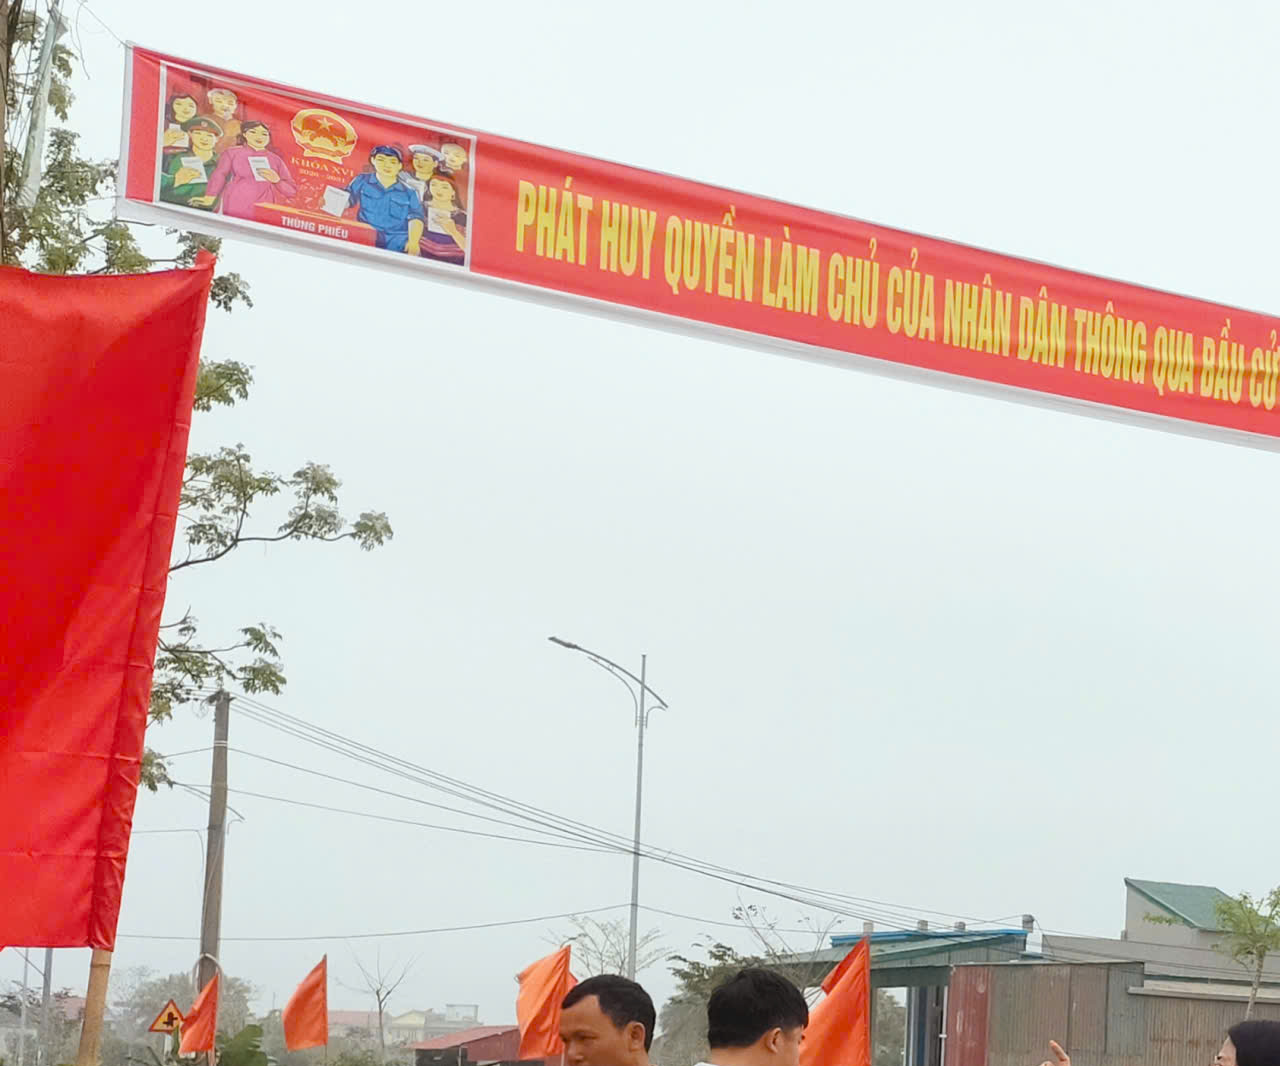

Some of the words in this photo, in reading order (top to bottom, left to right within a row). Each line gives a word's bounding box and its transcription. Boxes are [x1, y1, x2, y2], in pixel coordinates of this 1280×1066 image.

[332, 165, 354, 177] XVI
[281, 215, 316, 232] THÙNG
[318, 223, 349, 239] PHIẾU
[516, 176, 593, 266] PHÁT
[600, 200, 657, 280] HUY
[664, 205, 756, 302] QUYỀN
[762, 226, 820, 316] LÀM
[828, 237, 880, 329] CHỦ
[886, 248, 936, 342] CỦA
[943, 273, 1012, 357] NHÂN
[1018, 286, 1068, 368] DÂN
[1074, 300, 1147, 385] THÔNG
[1153, 326, 1195, 396] QUA
[1200, 318, 1245, 404] BẦU
